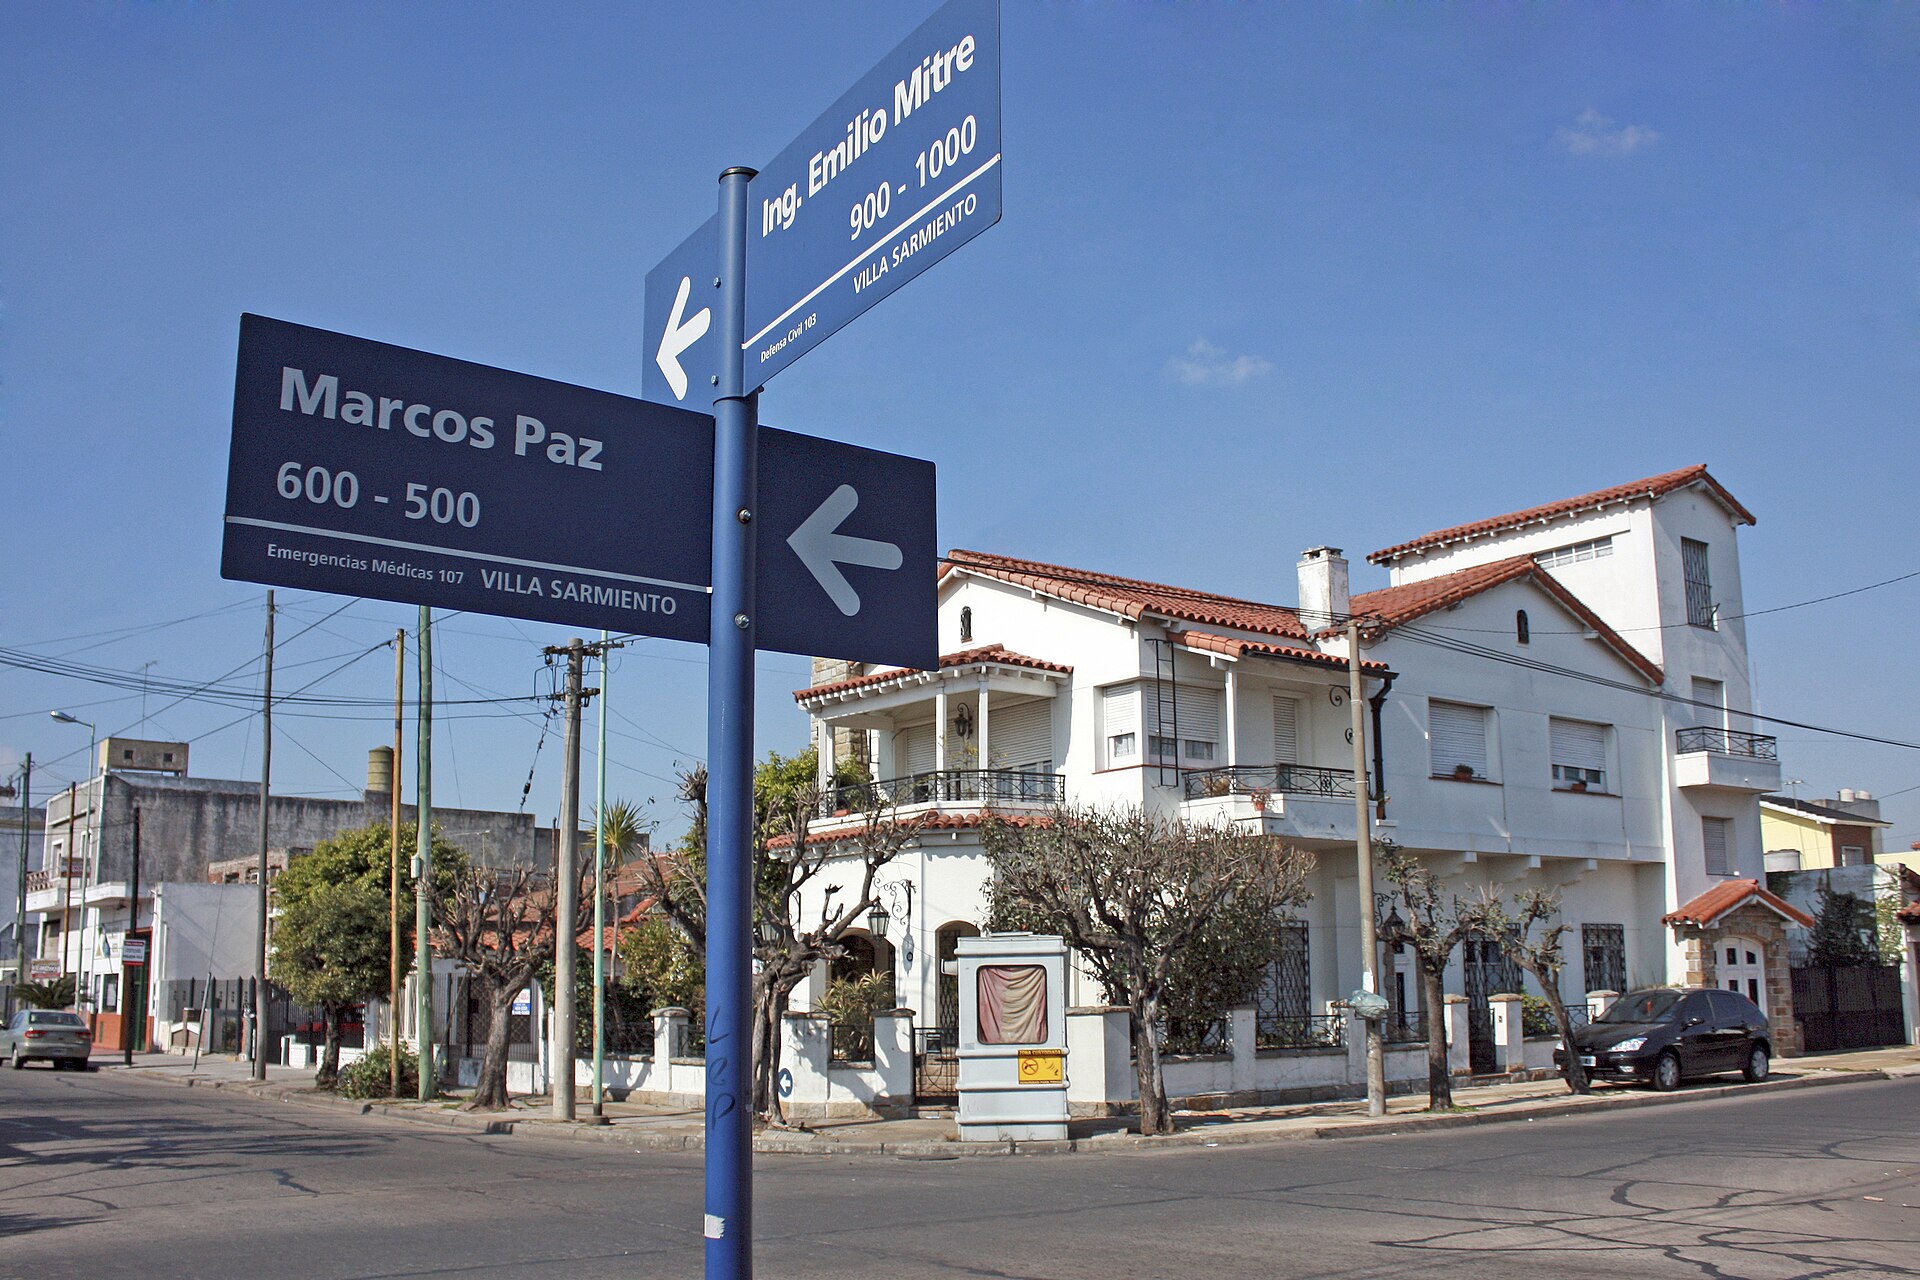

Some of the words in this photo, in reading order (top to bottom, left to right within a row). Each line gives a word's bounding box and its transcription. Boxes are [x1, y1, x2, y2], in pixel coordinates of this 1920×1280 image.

[762, 182, 802, 238] Ing.
[808, 108, 887, 199] Emilio
[894, 35, 975, 127] Mitre
[850, 181, 891, 241] 900
[897, 183, 906, 195] -
[915, 114, 977, 188] 1000
[853, 255, 889, 294] VILLA
[892, 193, 977, 268] SARMIENTO
[760, 337, 787, 363] Defensa
[787, 321, 803, 343] Civil
[804, 312, 817, 331] 103
[279, 366, 495, 449] Marcos
[514, 414, 603, 472] Paz
[277, 461, 359, 509] 600
[374, 495, 389, 504] -
[405, 482, 480, 528] 500
[267, 543, 367, 571] Emergencias
[371, 560, 433, 581] Médicas
[438, 569, 464, 584] 107
[480, 568, 544, 597] VILLA
[550, 579, 677, 615] SARMIENTO
